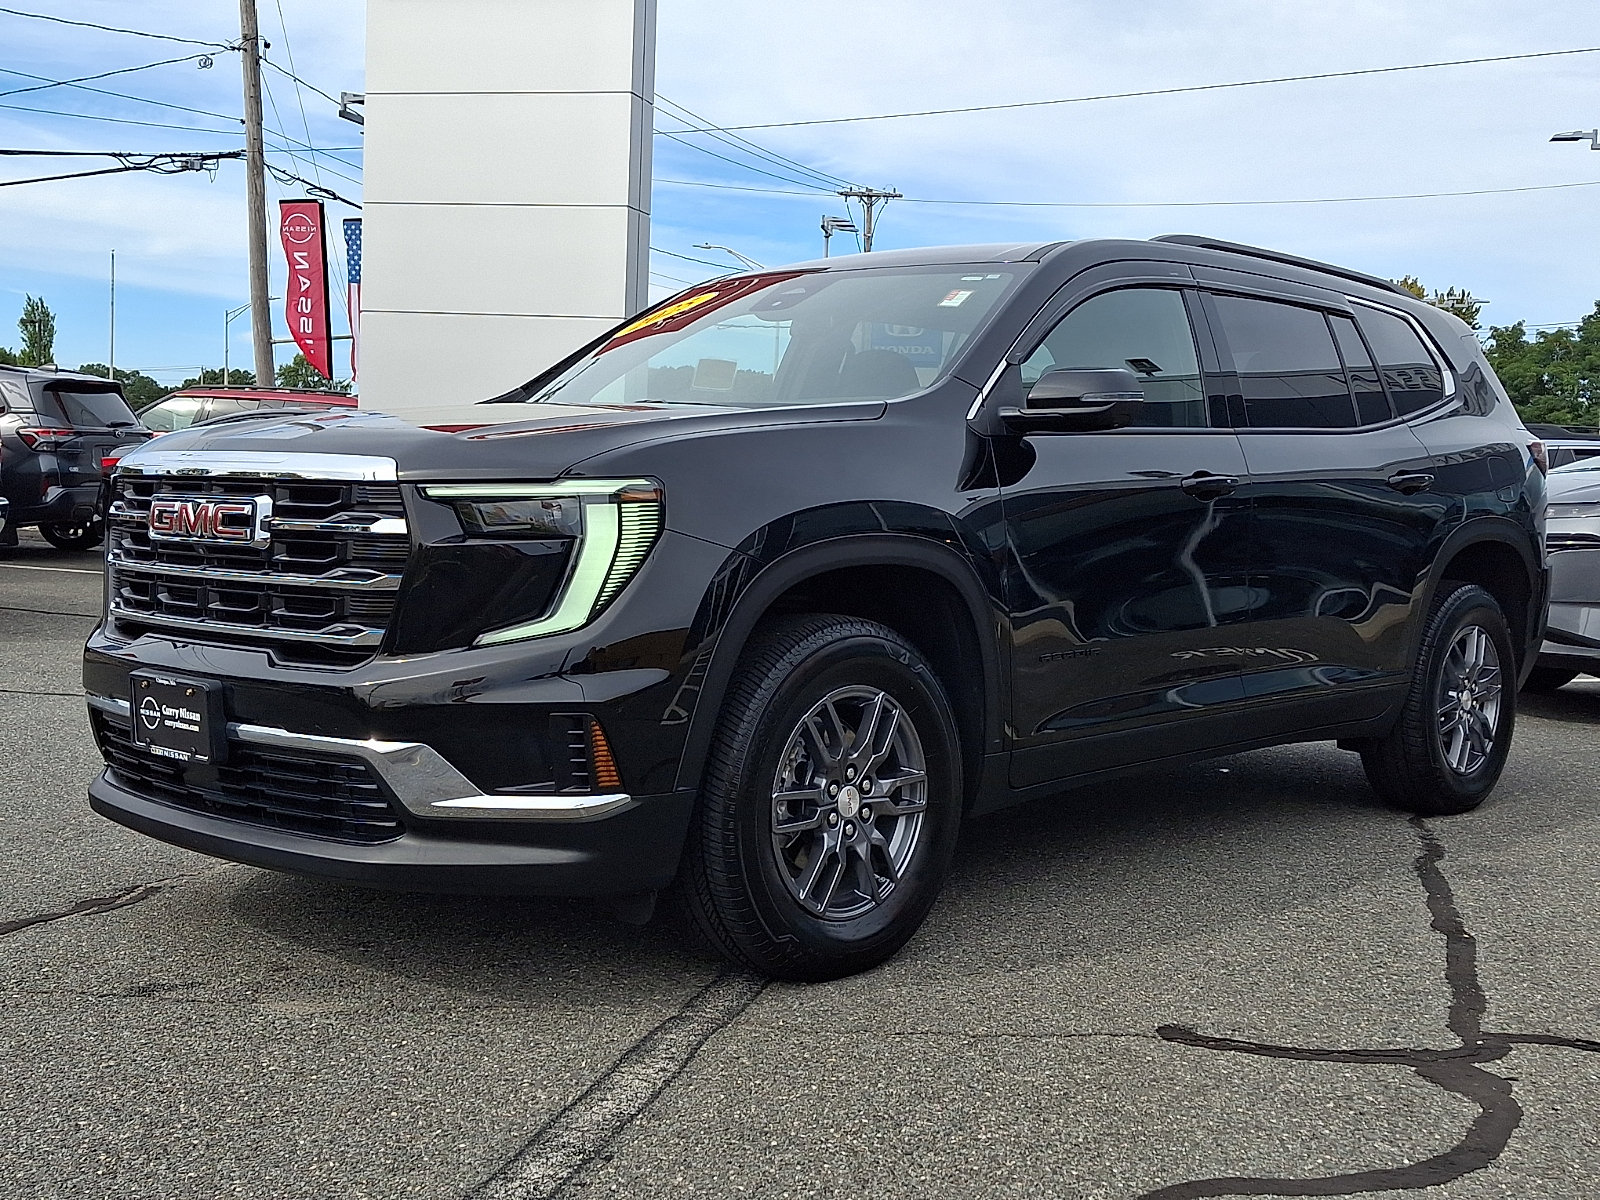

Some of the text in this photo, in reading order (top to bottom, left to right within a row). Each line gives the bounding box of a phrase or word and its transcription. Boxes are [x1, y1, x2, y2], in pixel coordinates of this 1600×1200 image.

[151, 501, 253, 540] GMC
[140, 708, 161, 718] NISSAN
[162, 704, 201, 722] Curry Nissan
